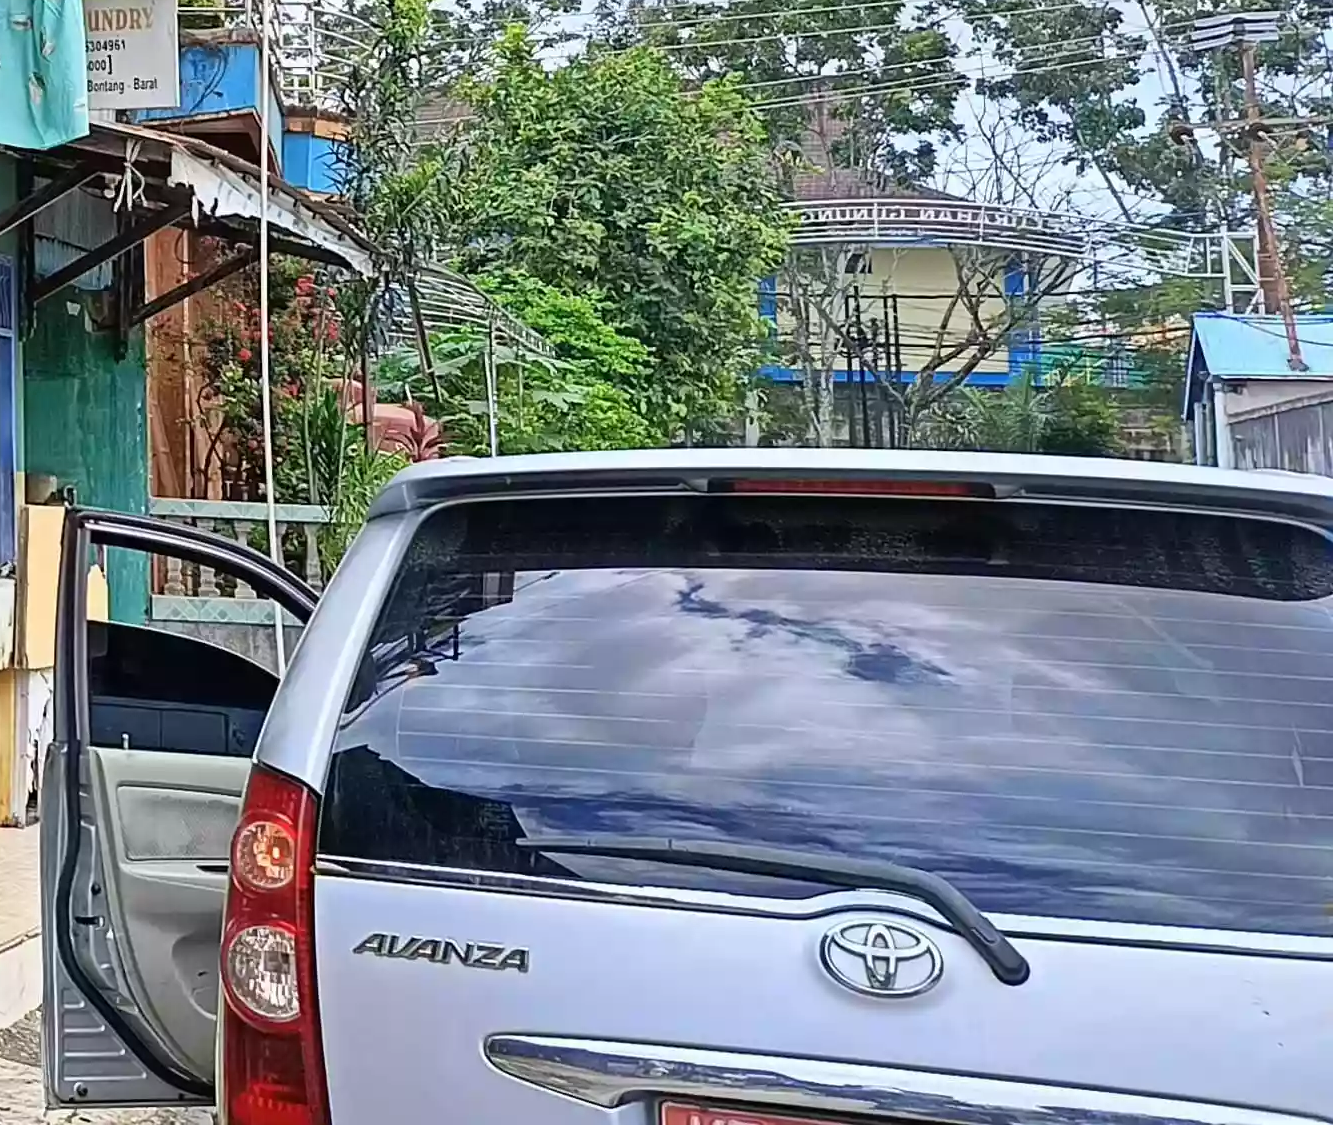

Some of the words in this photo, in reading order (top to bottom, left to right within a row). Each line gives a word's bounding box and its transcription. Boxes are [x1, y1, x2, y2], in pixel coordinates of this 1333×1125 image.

[87, 54, 112, 75] 000]
[87, 80, 124, 94] Bontang
[133, 77, 158, 90] Barat
[351, 931, 531, 974] AVANZA
